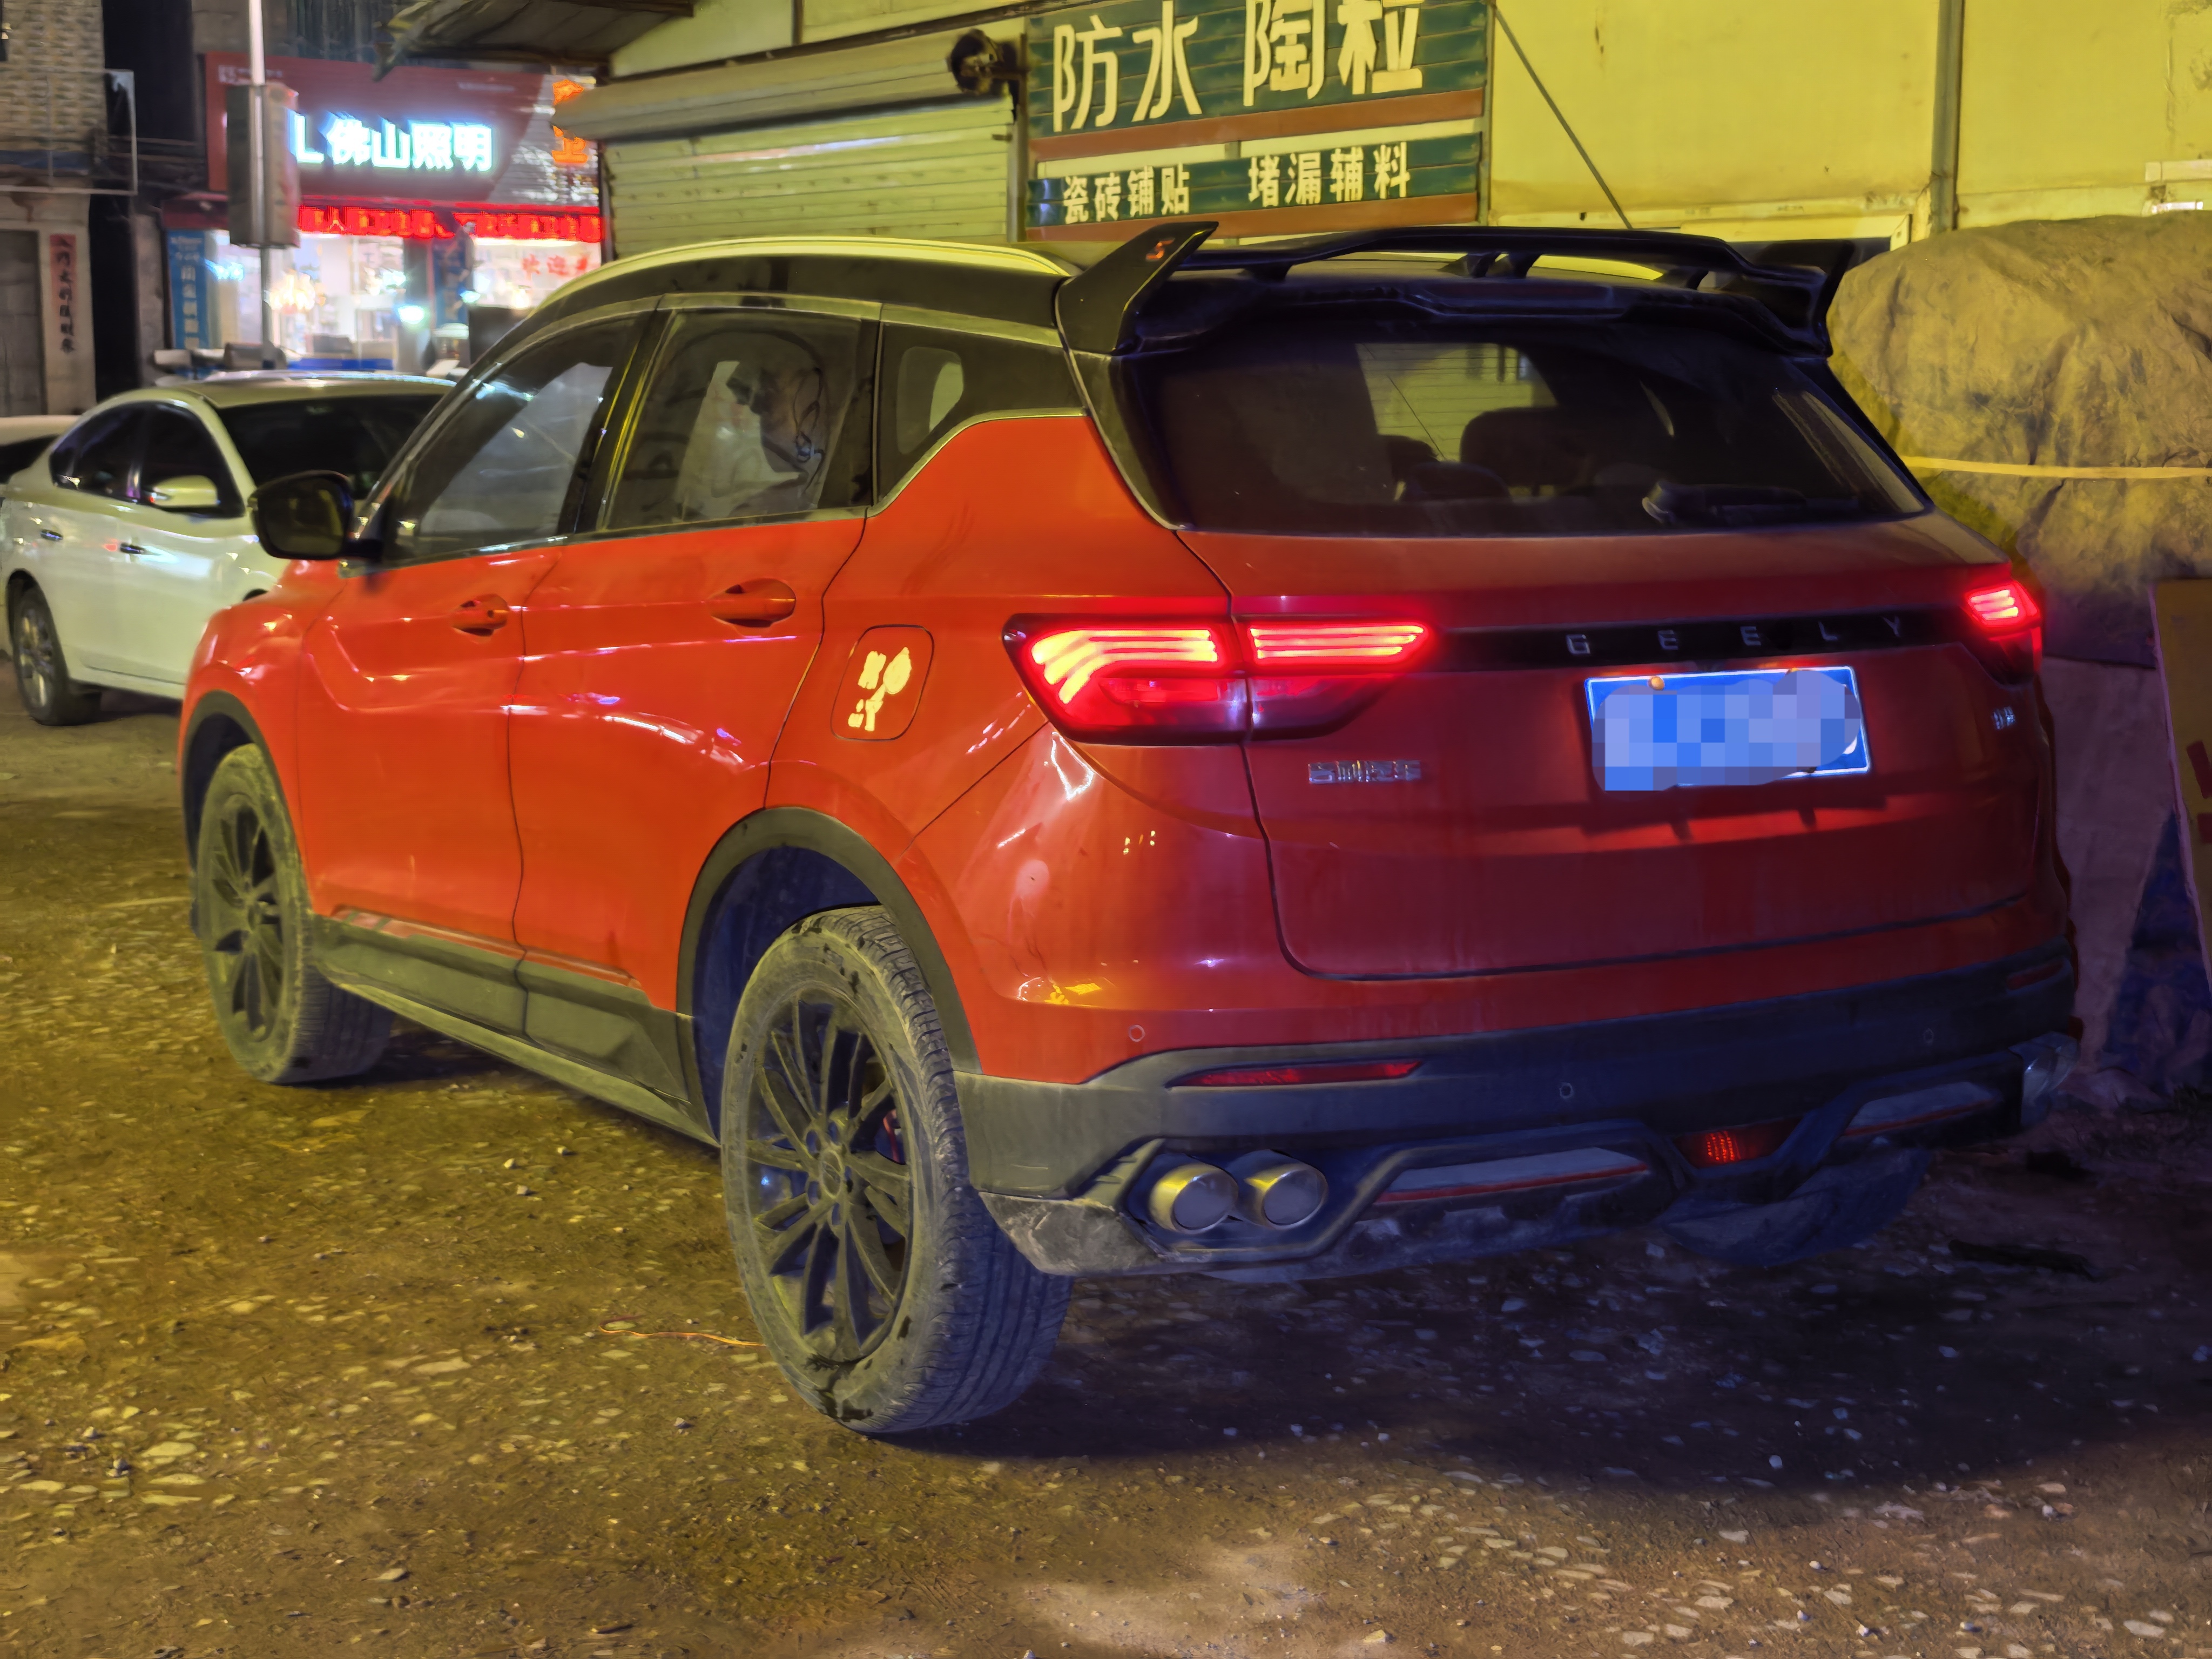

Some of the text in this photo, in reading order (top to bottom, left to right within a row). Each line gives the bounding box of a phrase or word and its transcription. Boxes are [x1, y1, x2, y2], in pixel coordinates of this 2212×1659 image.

[1053, 0, 1423, 132] 防水 陶粒
[1063, 141, 1411, 224] 瓷砖铺贴 堵漏辅料
[1566, 616, 1901, 655] GEELY
